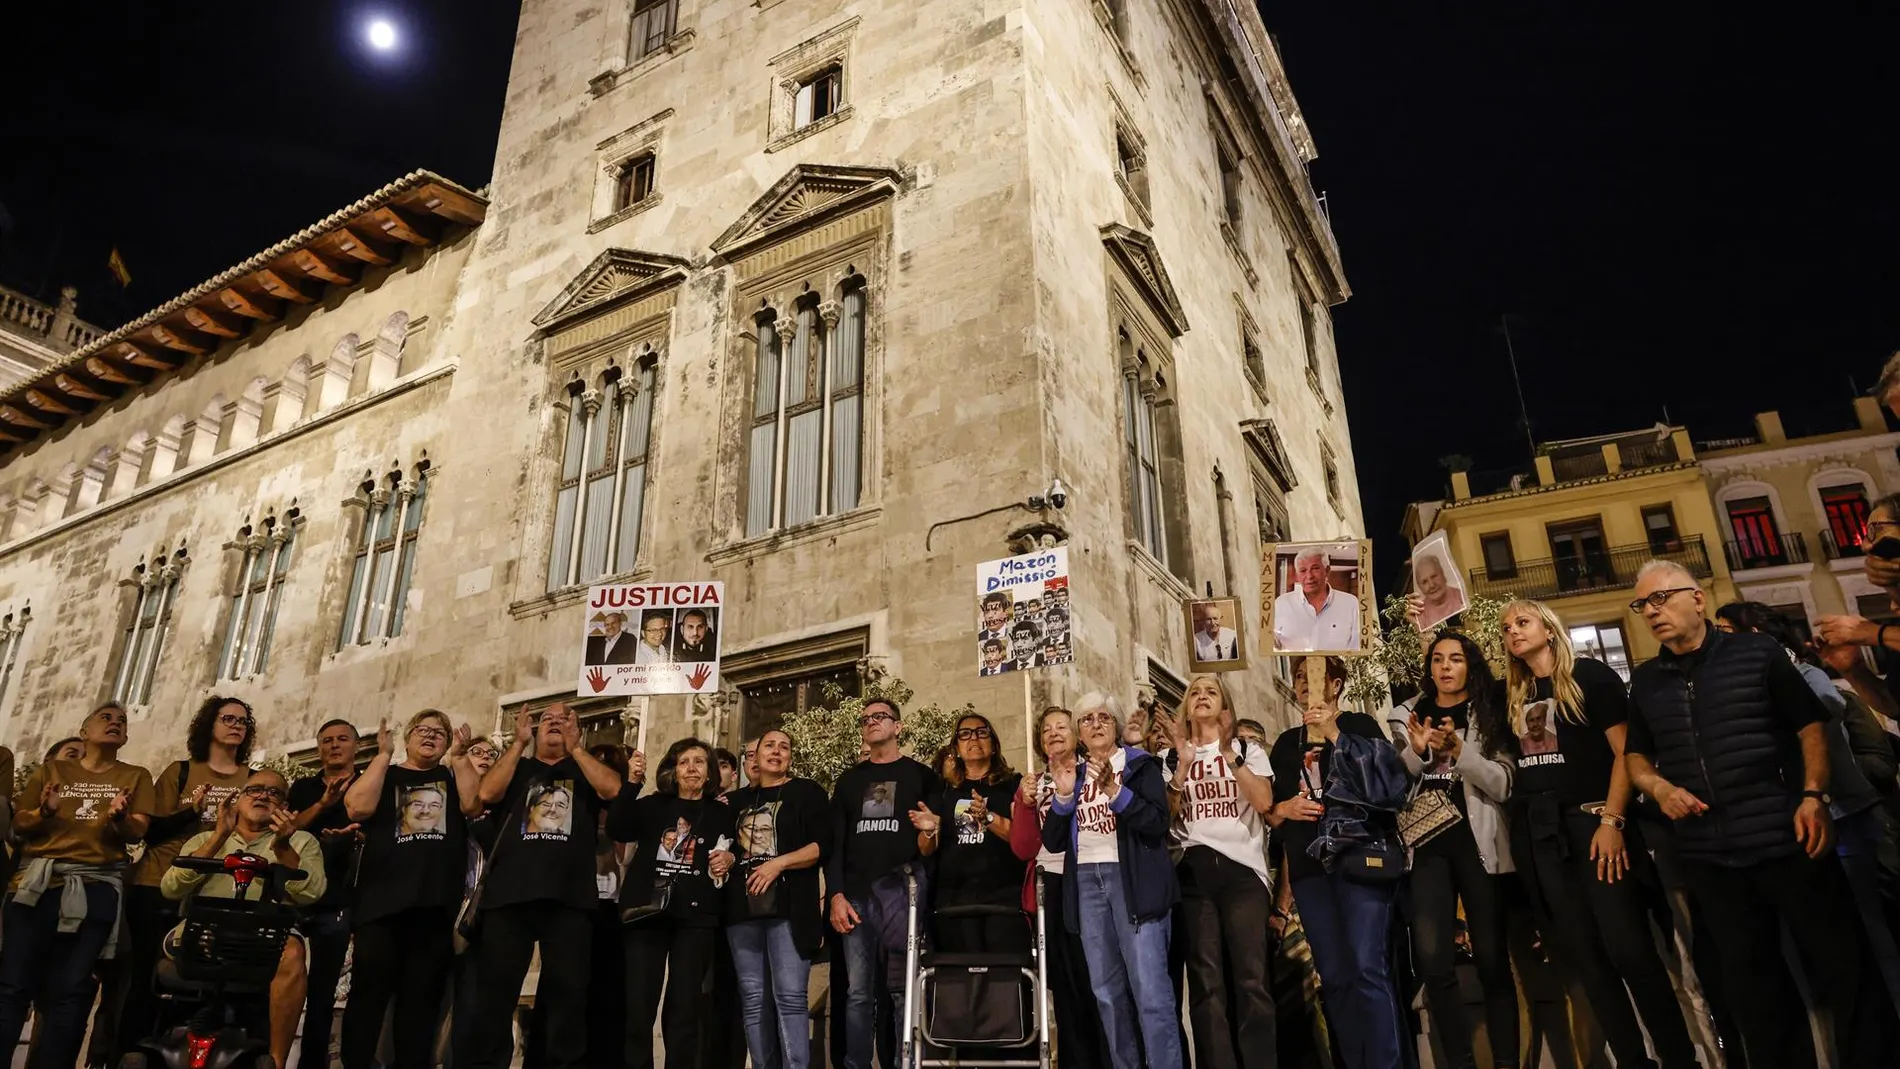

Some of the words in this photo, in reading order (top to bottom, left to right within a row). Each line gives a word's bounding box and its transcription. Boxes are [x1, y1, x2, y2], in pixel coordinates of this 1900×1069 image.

[1000, 551, 1056, 575] Mazón
[987, 565, 1056, 591] Dimissió
[591, 585, 720, 608] JUSTICIA
[1261, 551, 1273, 629] MAZÓN
[617, 666, 633, 674] por
[635, 664, 646, 672] mi
[1539, 753, 1565, 765] LUISA
[1196, 799, 1239, 820] PERDÓ
[856, 818, 899, 834] MANOLO
[397, 833, 413, 843] José
[415, 832, 444, 841] Vicente
[523, 832, 539, 841] José
[541, 832, 568, 842] Vicente
